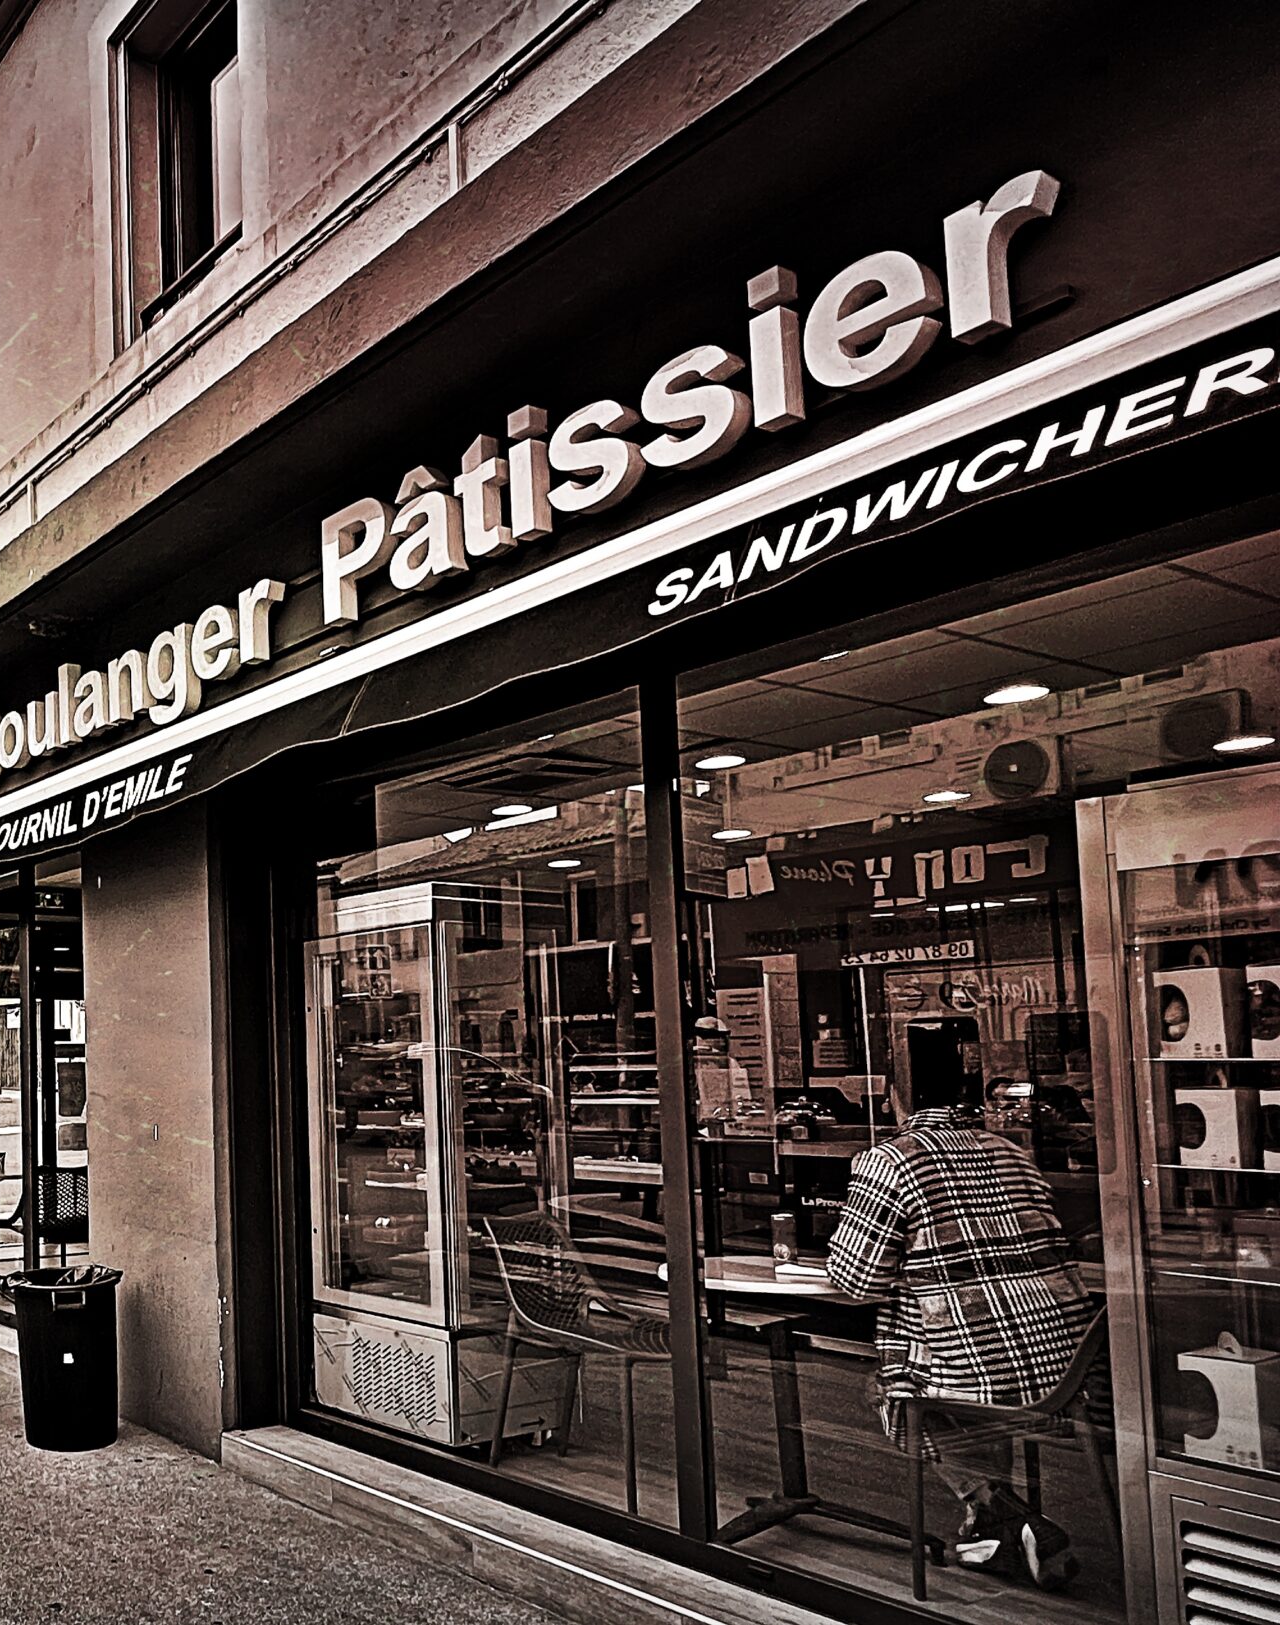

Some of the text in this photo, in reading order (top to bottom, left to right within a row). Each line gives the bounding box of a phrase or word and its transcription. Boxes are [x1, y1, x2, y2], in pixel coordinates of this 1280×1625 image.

[321, 169, 1060, 627] Pâtissier
[647, 347, 1280, 616] SANDWICHER
[82, 754, 194, 829] D'EMILE
[801, 1196, 815, 1206] La
